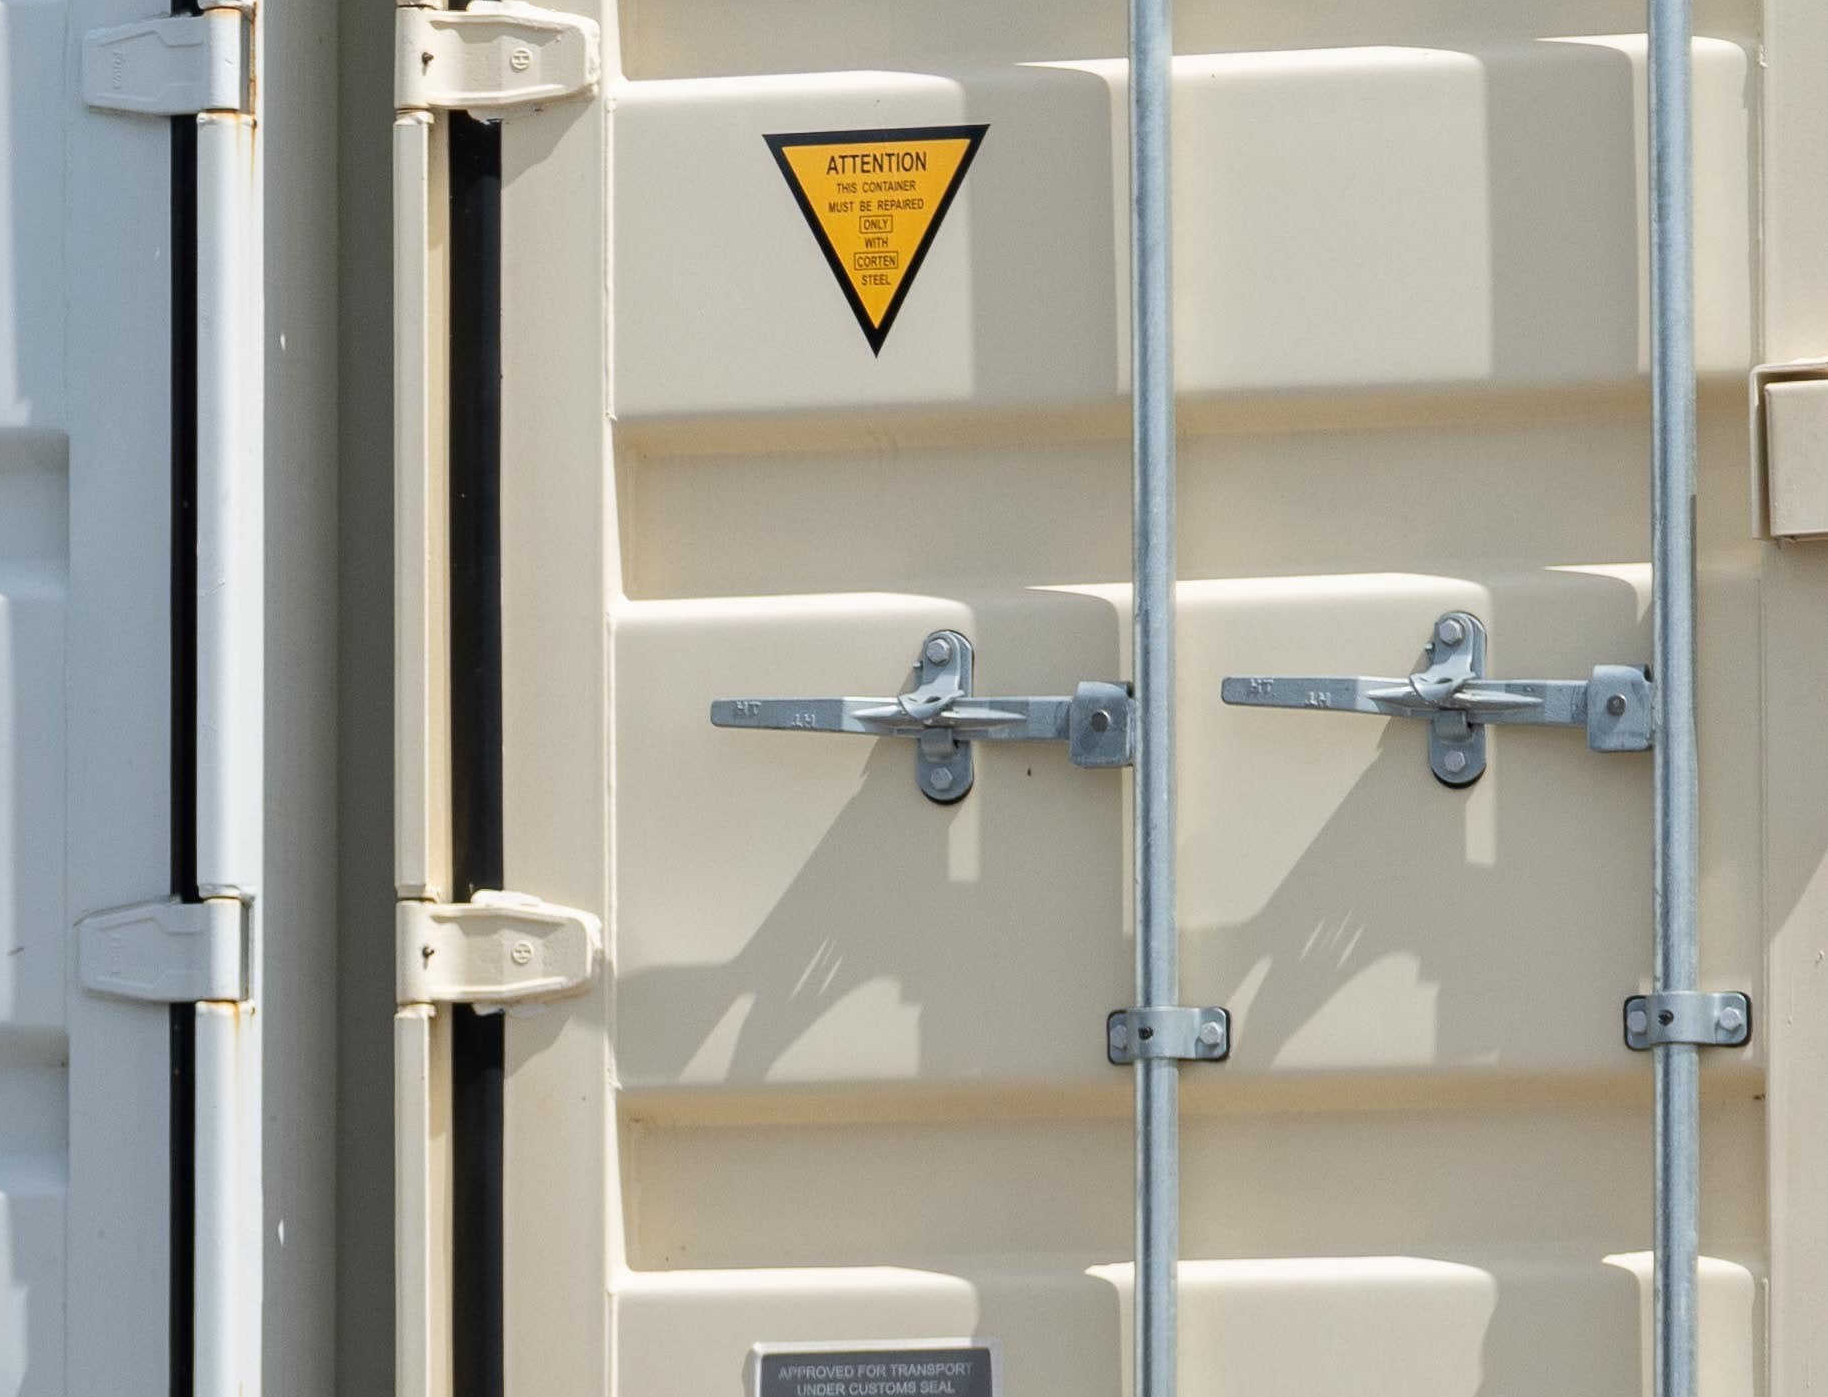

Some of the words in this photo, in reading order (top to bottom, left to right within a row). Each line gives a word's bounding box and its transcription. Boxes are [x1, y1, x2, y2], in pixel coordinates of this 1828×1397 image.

[826, 151, 927, 175] ATTENTION
[836, 183, 857, 194] THIS
[862, 180, 916, 193] CONTAINER
[828, 201, 854, 213] MUST
[859, 201, 872, 212] BE
[877, 198, 924, 210] REPAIRED
[863, 219, 889, 230] ONLY
[865, 237, 889, 249] WITH
[857, 255, 896, 268] CORTEN
[861, 275, 891, 286] STEEL
[778, 1365, 854, 1381] APPROVED
[857, 1364, 886, 1378] FOR
[890, 1362, 973, 1377] TRANSPORT
[797, 1383, 846, 1397] UNDER
[848, 1381, 917, 1396] CUSTOMS
[920, 1380, 956, 1394] SEAL
